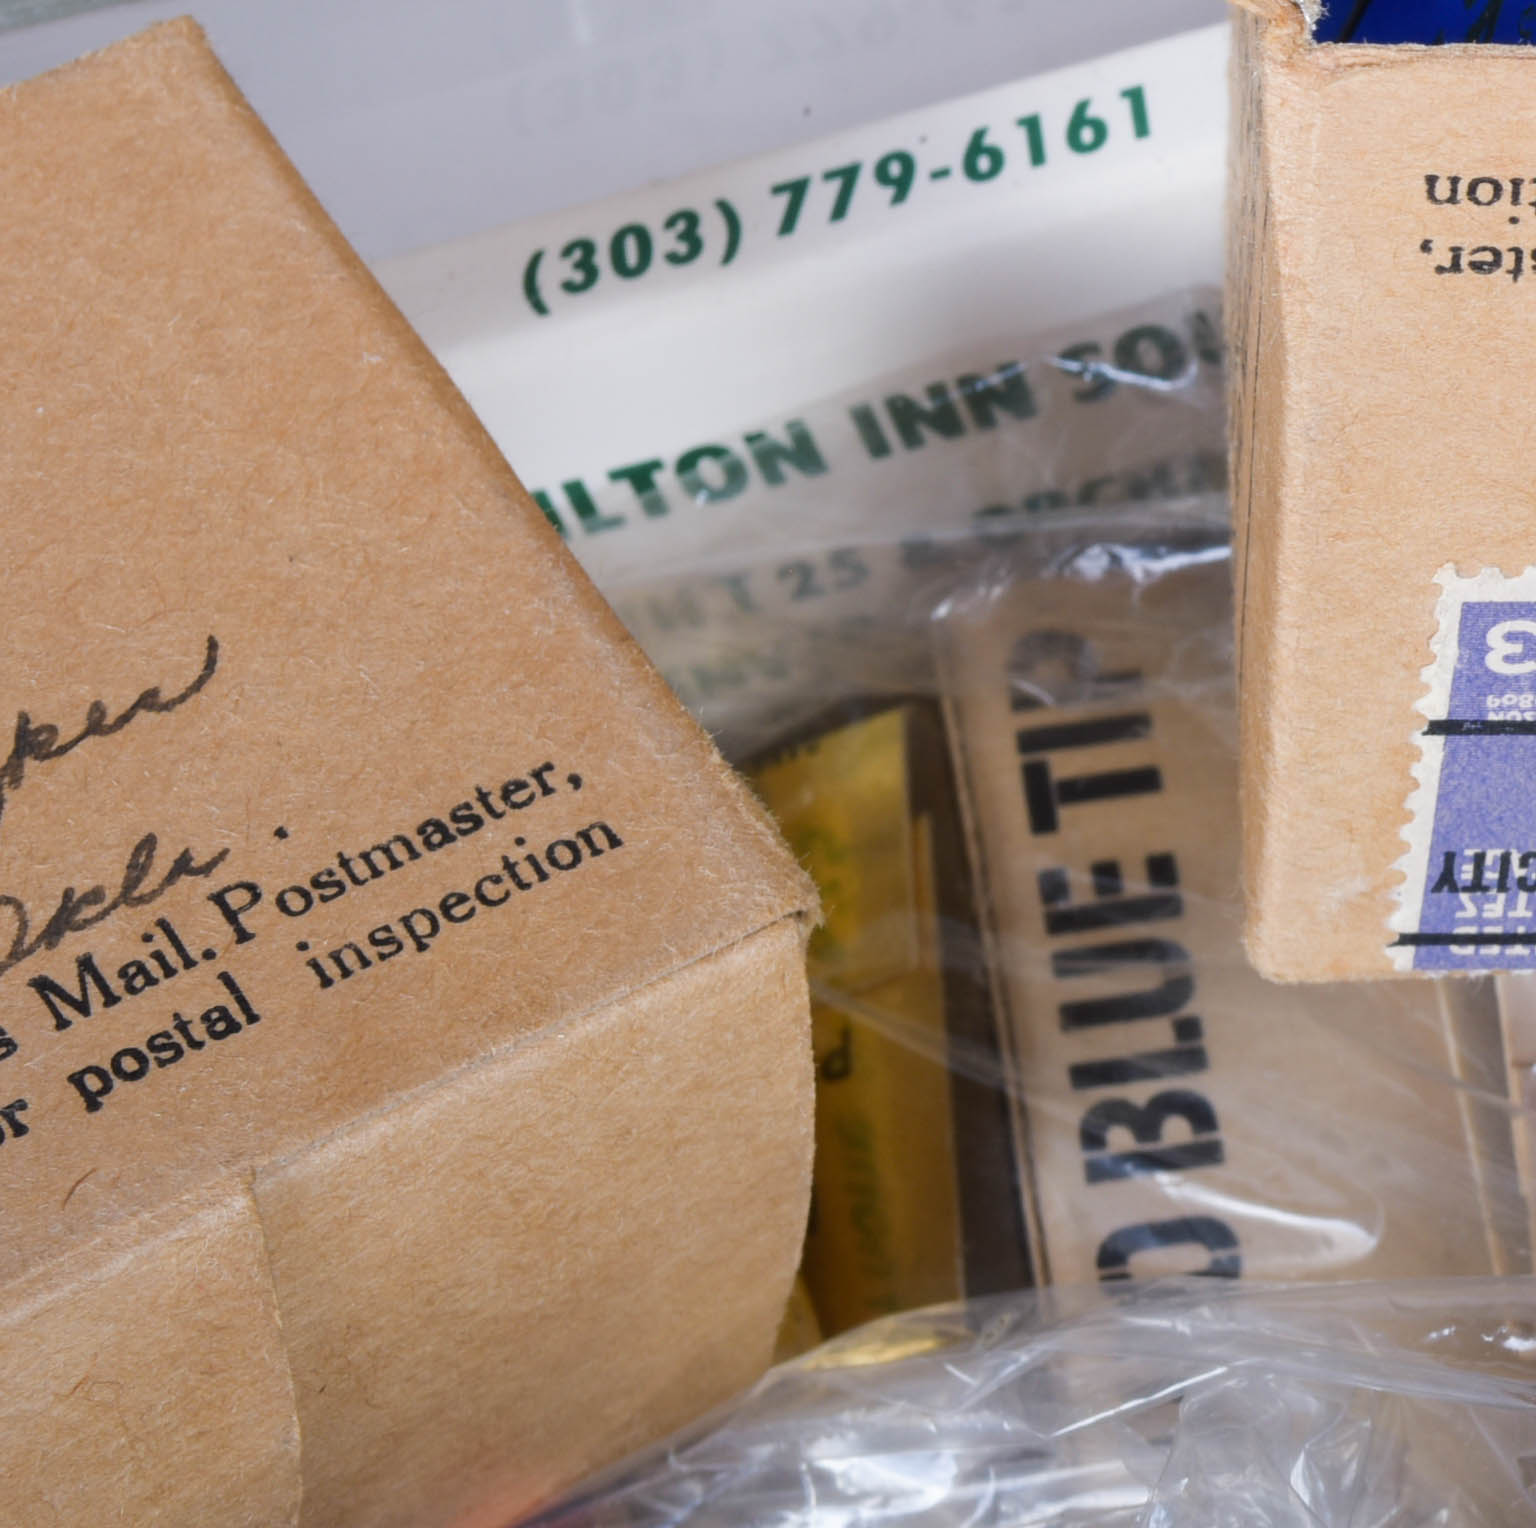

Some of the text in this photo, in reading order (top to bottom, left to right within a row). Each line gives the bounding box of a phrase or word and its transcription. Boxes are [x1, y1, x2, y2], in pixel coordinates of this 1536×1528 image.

[523, 84, 1152, 317] (303) 779-6161
[847, 359, 1038, 461] INN
[1009, 628, 1164, 836] TIP
[27, 760, 584, 1033] Mail. Postmaster,
[66, 818, 625, 1114] postal inspection
[1038, 851, 1226, 1185] BLUE
